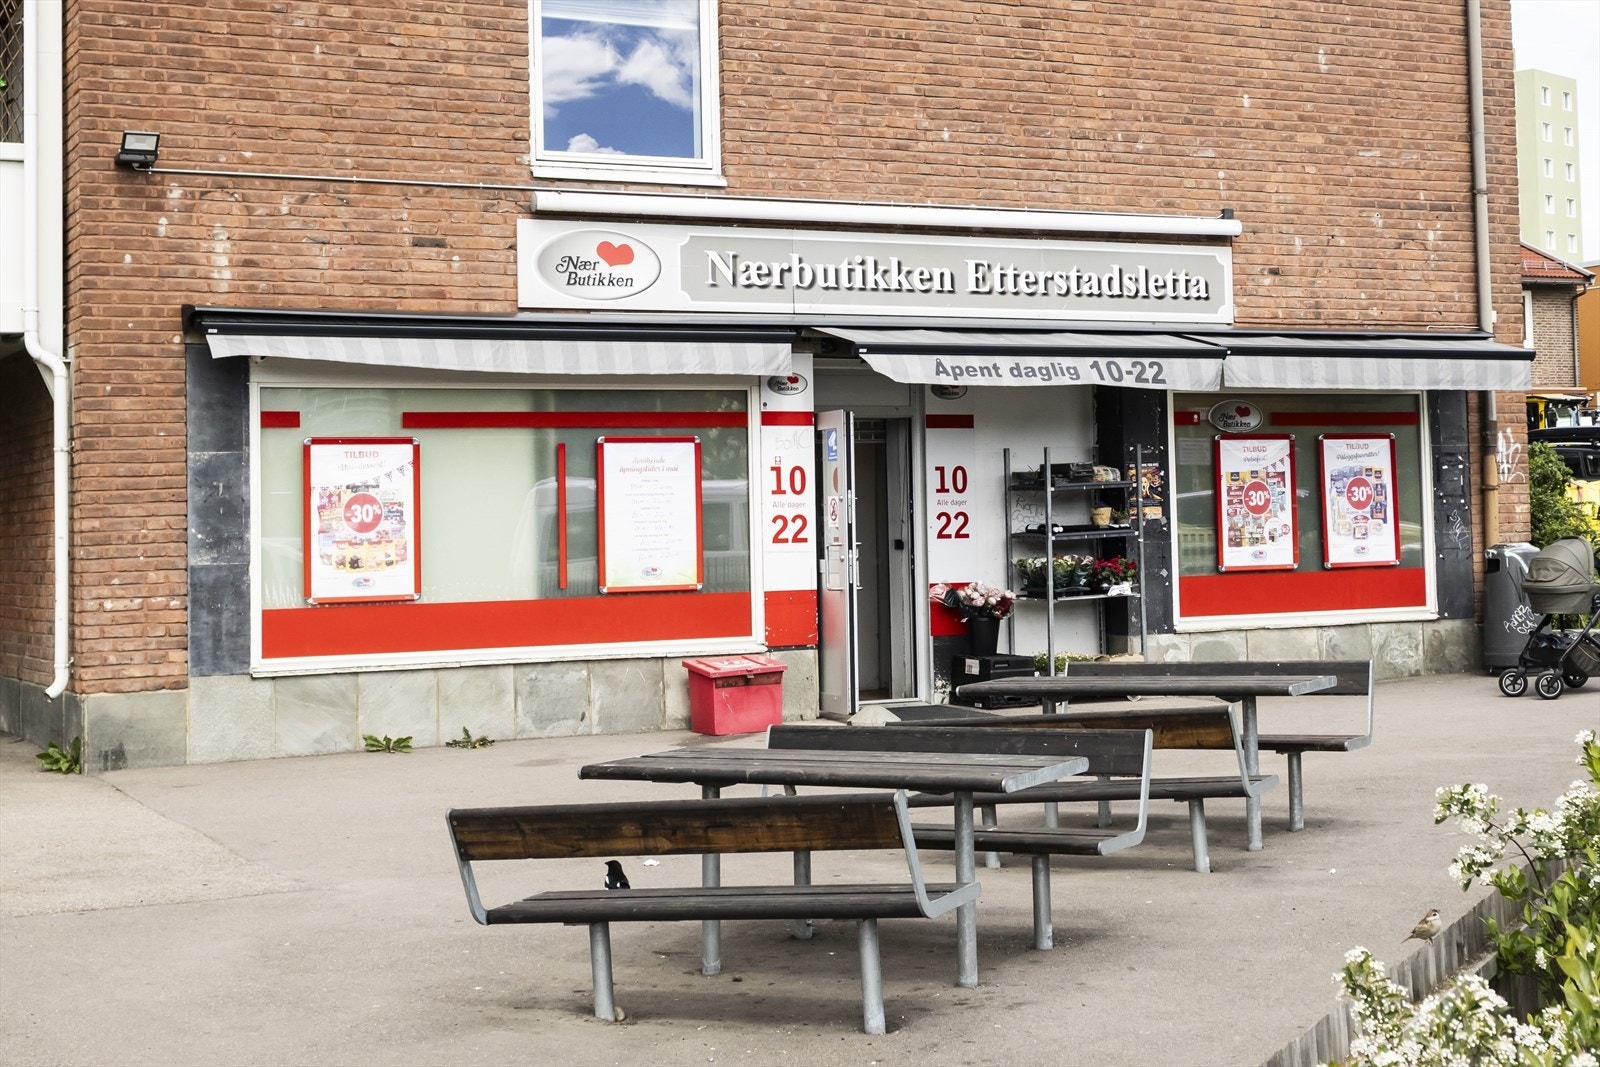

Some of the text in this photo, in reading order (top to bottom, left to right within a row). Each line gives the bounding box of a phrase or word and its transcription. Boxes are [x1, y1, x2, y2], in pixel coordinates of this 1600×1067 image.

[555, 255, 599, 271] Nær
[566, 271, 634, 288] Butikken
[704, 250, 1209, 299] Nærbutikken Etterstadsletta
[935, 358, 1167, 384] Åpent daglig 10-22
[1223, 420, 1251, 428] Butikken
[343, 451, 380, 459] TILBUD
[770, 465, 806, 496] 10
[934, 465, 968, 494] 10
[1245, 490, 1270, 506] -30%
[1348, 486, 1372, 502] -30%
[772, 500, 806, 510] Alle dager
[950, 499, 967, 507] dager
[345, 504, 381, 523] -30%
[771, 513, 808, 544] 22
[935, 511, 970, 540] 22
